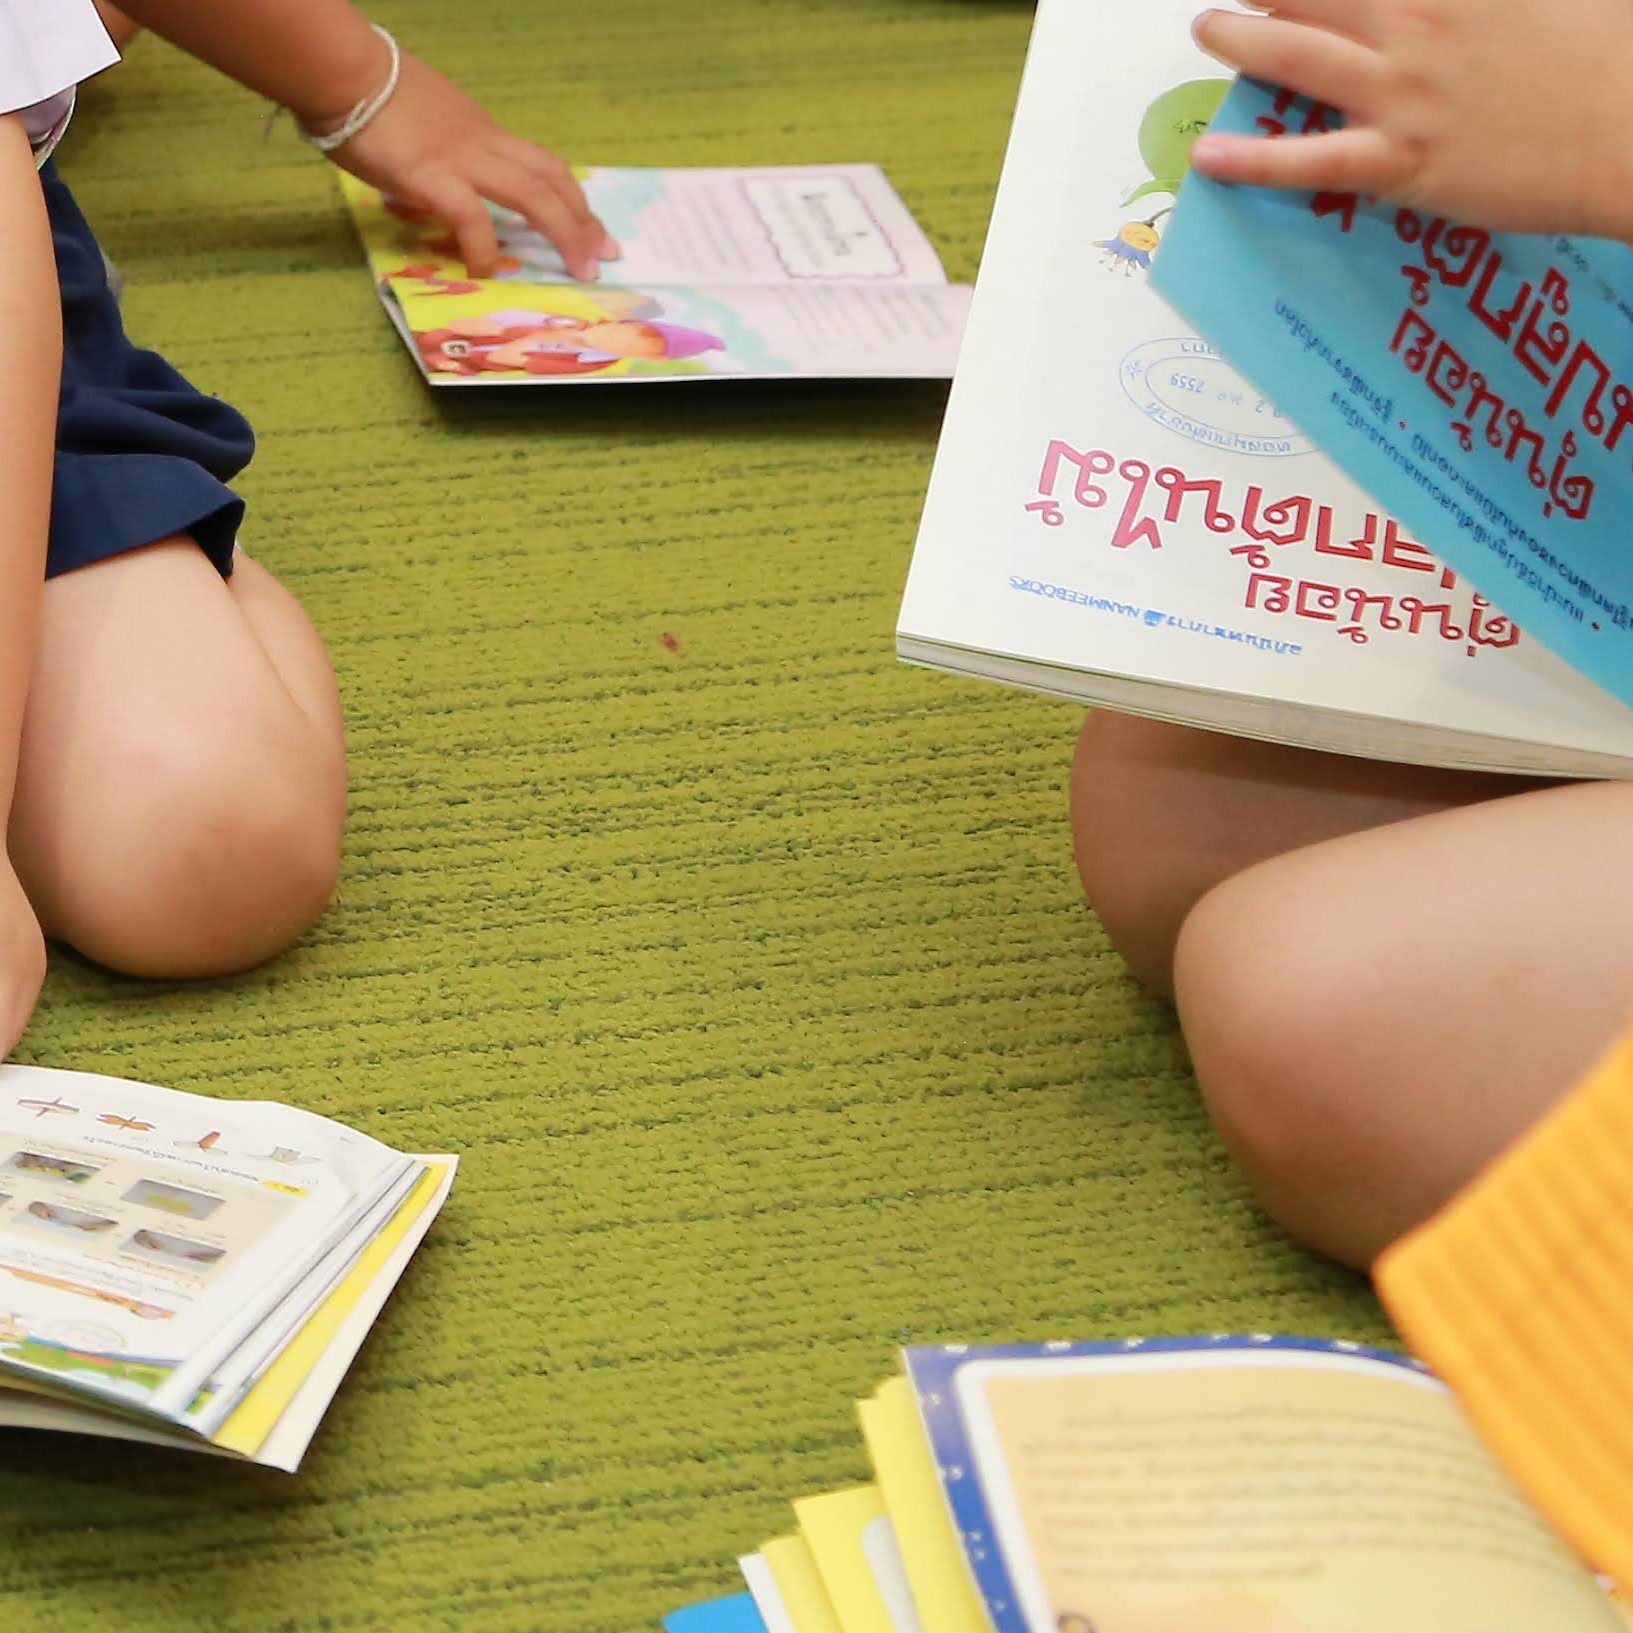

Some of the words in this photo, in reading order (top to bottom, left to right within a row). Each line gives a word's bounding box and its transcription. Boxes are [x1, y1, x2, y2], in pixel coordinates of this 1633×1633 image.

[1387, 308, 1595, 520] ตุ่นน้อย
[1007, 575, 1141, 618] NANMEEBOOKS
[1246, 572, 1521, 658] ตุ่นน้อย
